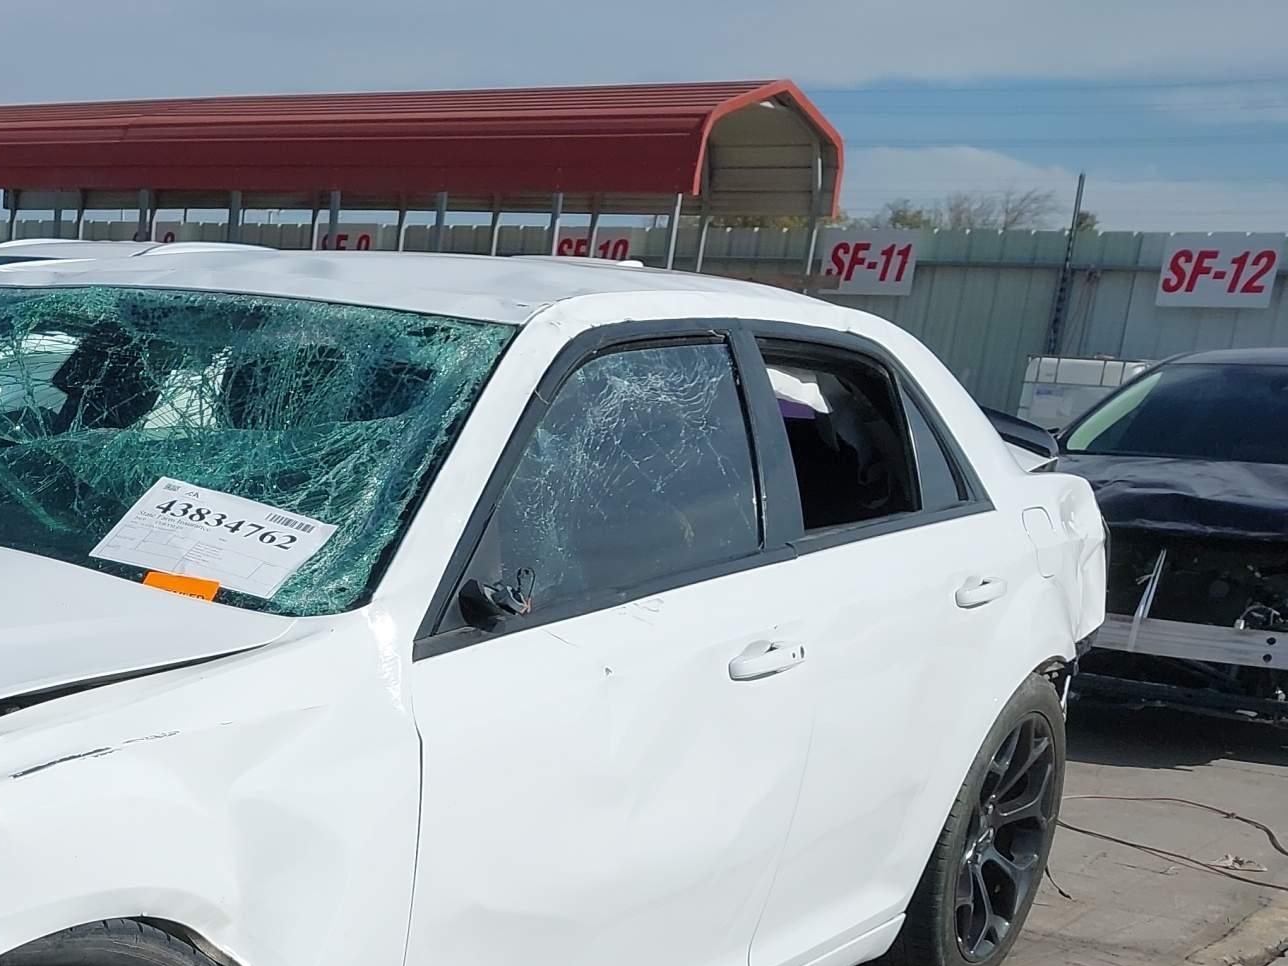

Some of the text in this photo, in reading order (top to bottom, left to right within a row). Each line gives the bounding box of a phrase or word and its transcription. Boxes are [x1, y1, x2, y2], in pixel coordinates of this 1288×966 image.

[825, 242, 912, 282] SF-11
[1161, 249, 1276, 293] SF-12
[156, 500, 298, 550] 43834762
